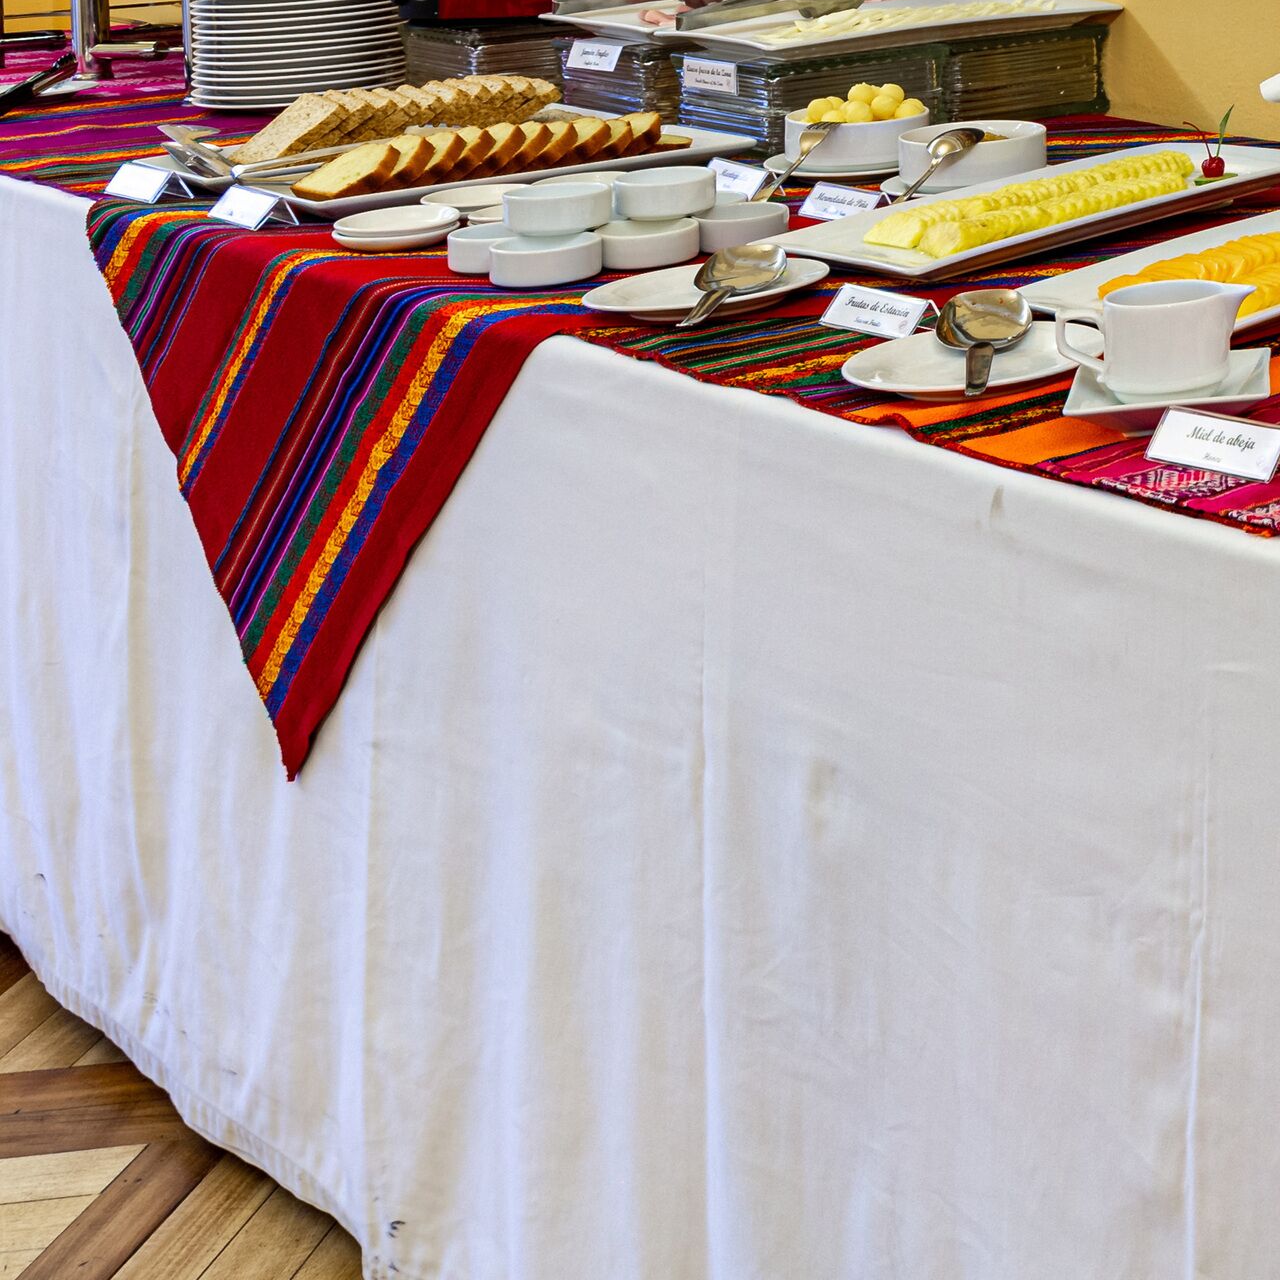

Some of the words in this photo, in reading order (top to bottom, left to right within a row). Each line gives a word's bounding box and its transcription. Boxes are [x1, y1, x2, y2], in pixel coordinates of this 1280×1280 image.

[845, 296, 870, 310] Frutas
[869, 300, 880, 312] de
[1186, 425, 1212, 442] Miel
[1211, 430, 1225, 444] de
[1226, 432, 1256, 453] abeja
